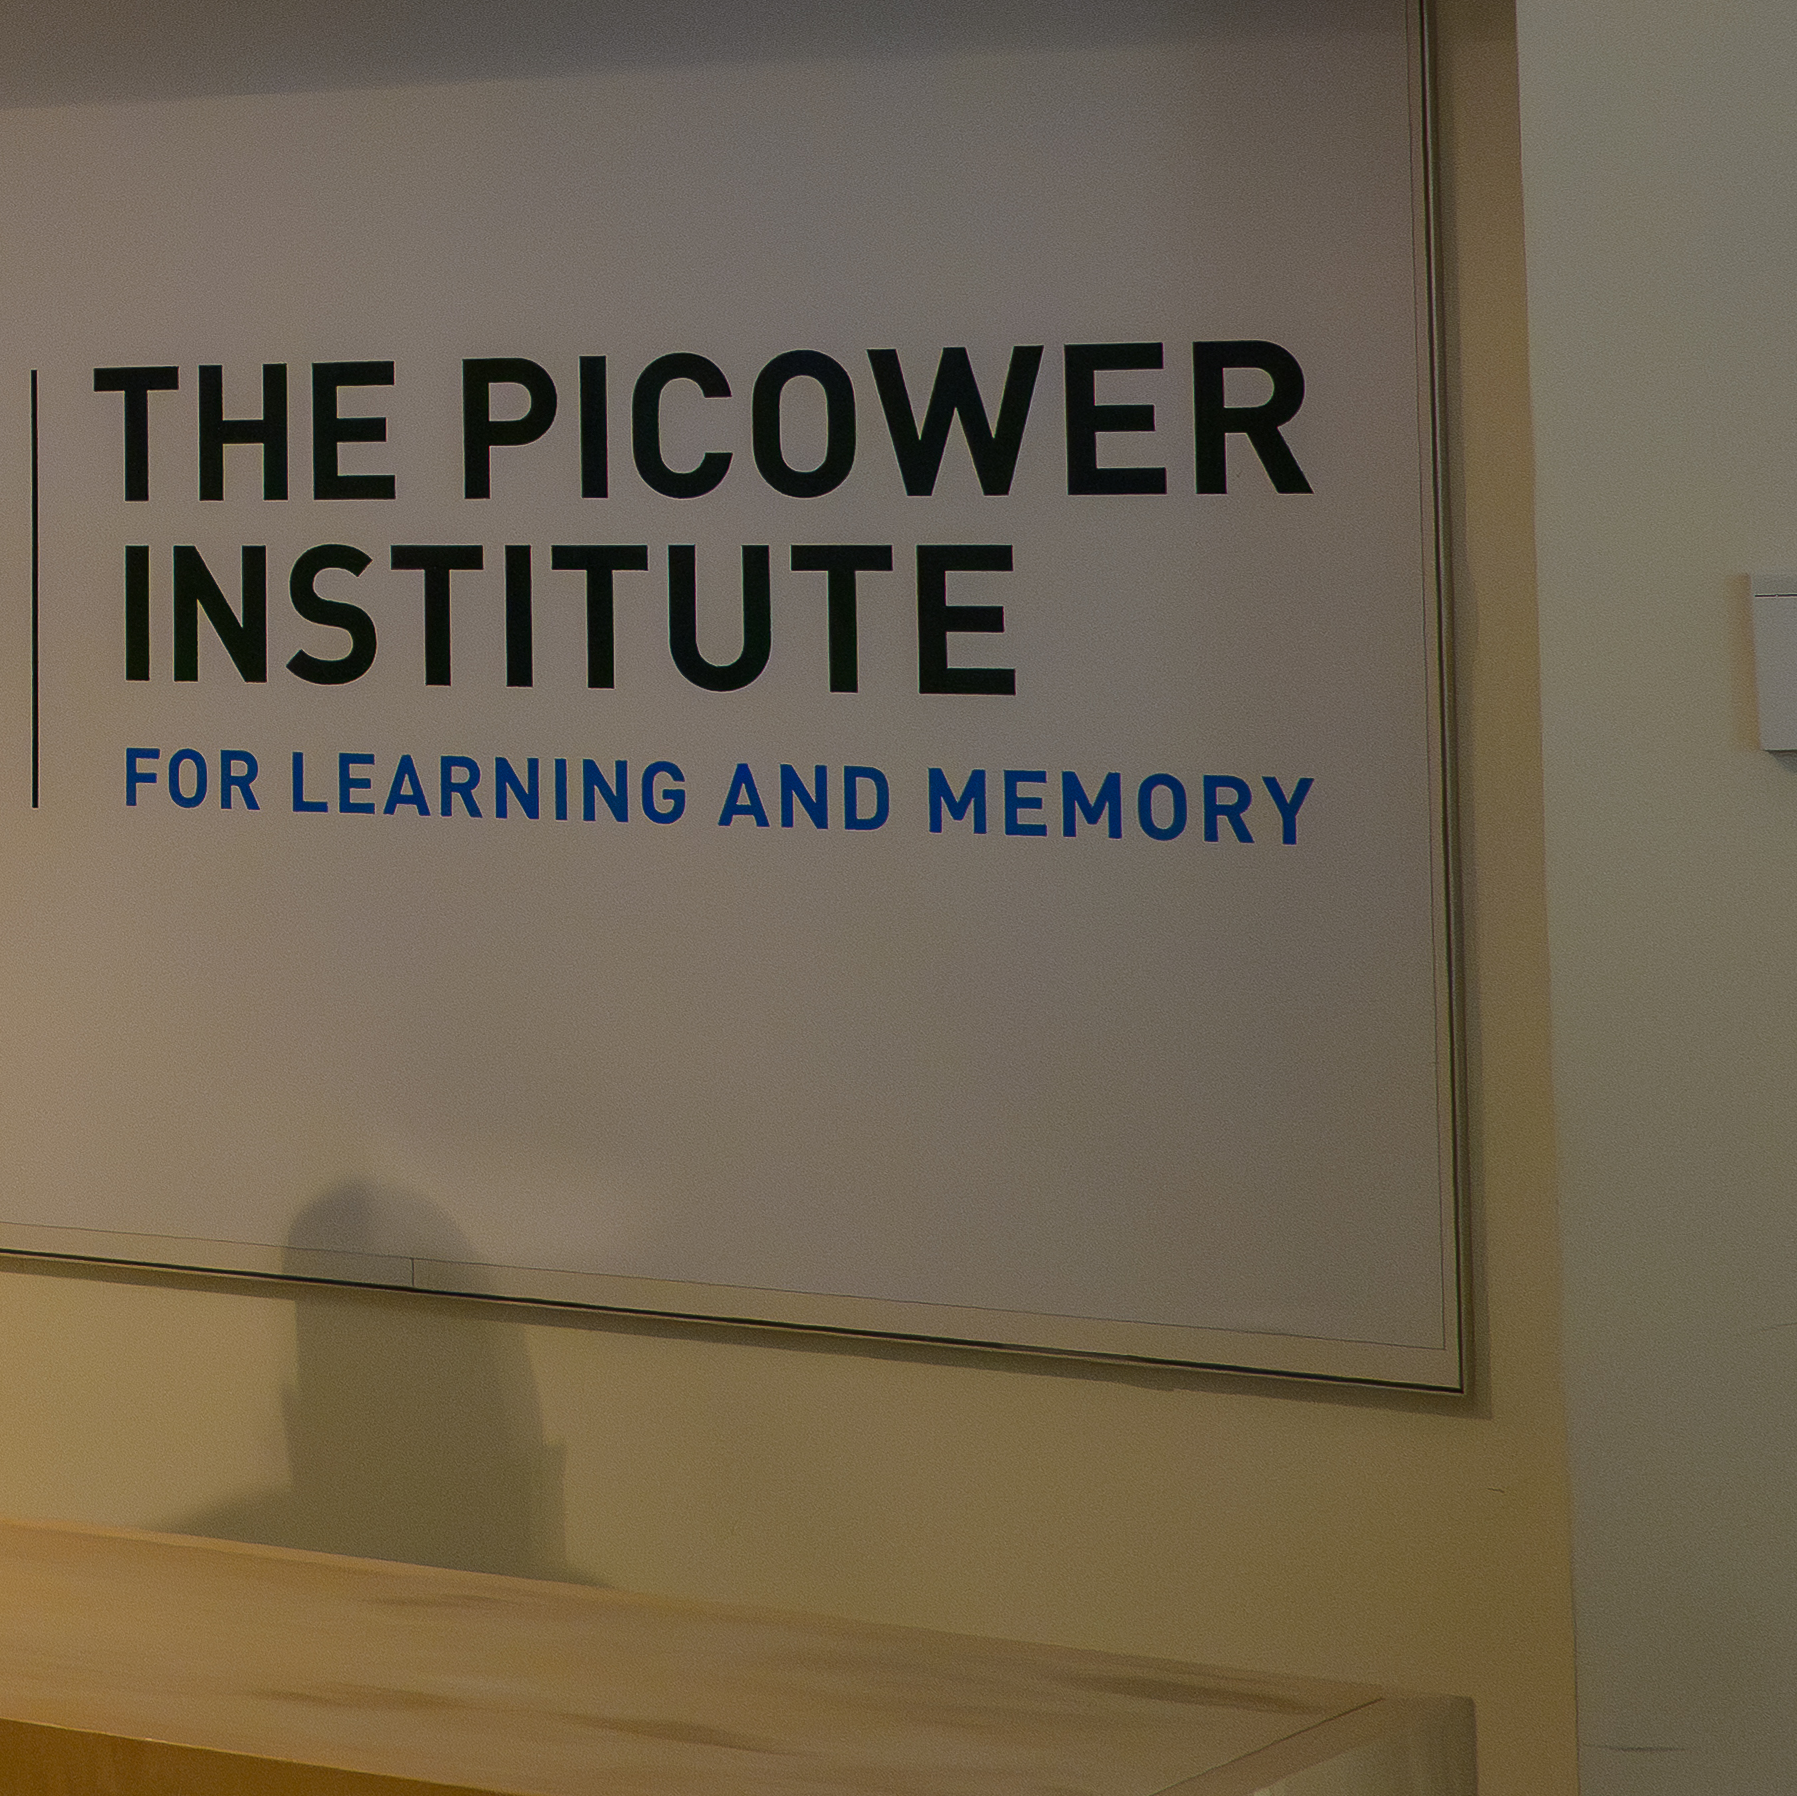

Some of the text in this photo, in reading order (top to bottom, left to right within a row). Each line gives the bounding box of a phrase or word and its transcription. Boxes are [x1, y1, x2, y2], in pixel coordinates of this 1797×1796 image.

[92, 339, 1315, 505] THE PICOWER
[124, 540, 1019, 698] INSTITUTE
[124, 745, 1317, 848] FOR LEARNING AND MEMORY
